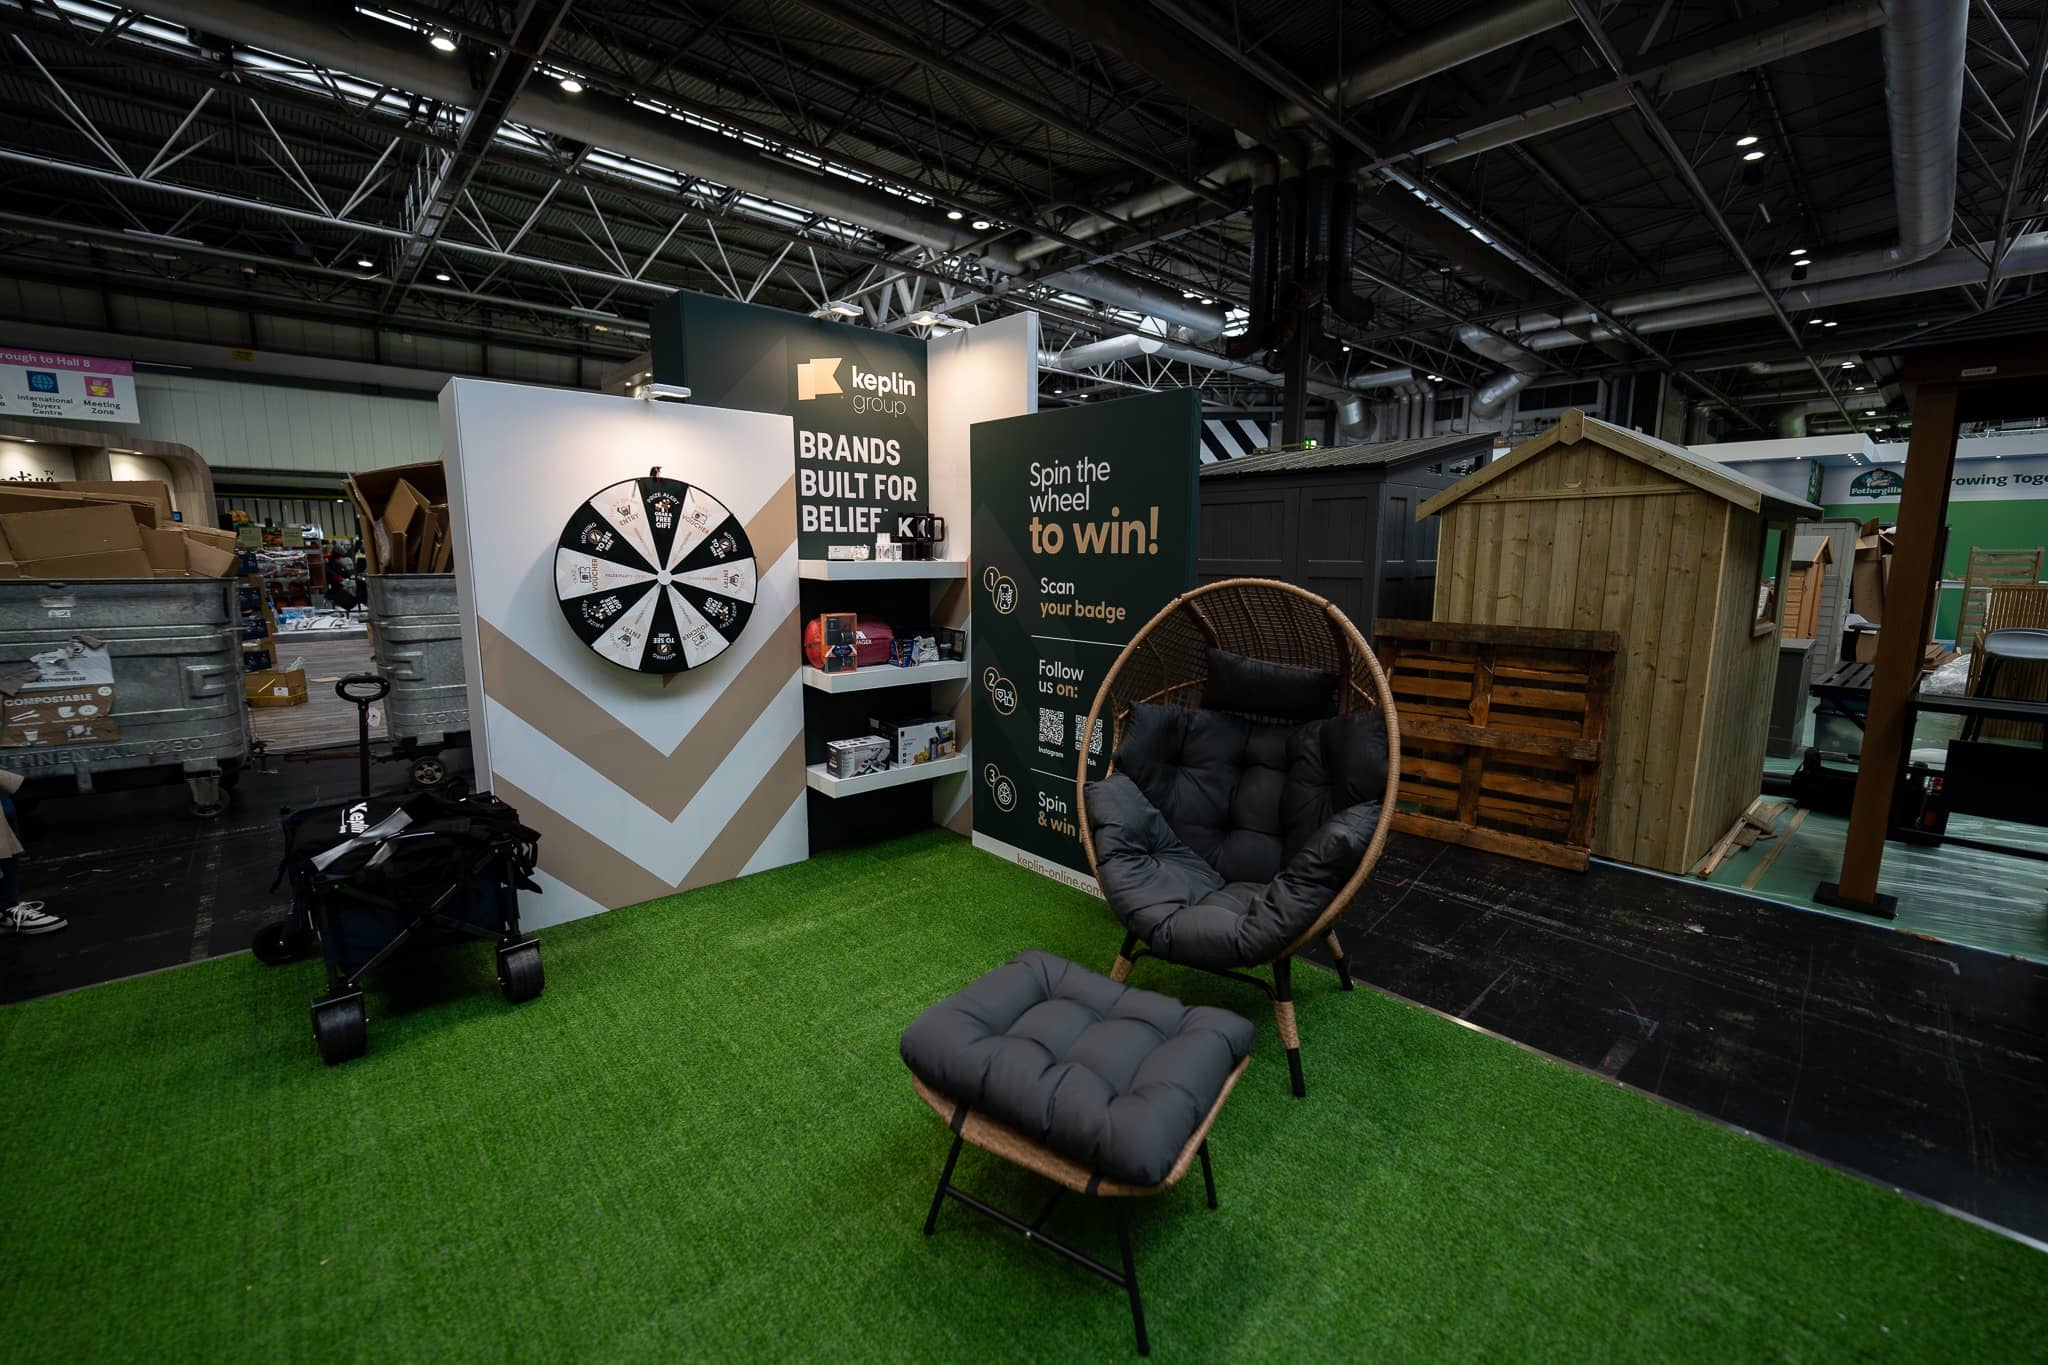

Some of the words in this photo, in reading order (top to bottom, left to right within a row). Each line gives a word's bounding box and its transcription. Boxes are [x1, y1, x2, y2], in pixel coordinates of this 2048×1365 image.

[0, 352, 37, 364] rough
[40, 355, 53, 364] to
[60, 358, 80, 367] Hall
[83, 360, 91, 368] 8
[852, 365, 915, 397] keplin
[84, 400, 121, 409] Meeting
[91, 408, 115, 416] Zone
[853, 394, 907, 418] group
[799, 430, 901, 466] BRANDS
[1030, 459, 1071, 492] Spin
[1076, 456, 1111, 483] the
[800, 468, 868, 499] BUILT
[874, 474, 918, 502] FOR
[662, 493, 680, 505] ALERT
[1030, 484, 1090, 513] wheel
[619, 513, 639, 526] ENTRY
[682, 513, 710, 534] VOUCHER
[898, 517, 914, 537] K
[1029, 516, 1064, 555] to
[1072, 506, 1159, 555] win!
[595, 542, 605, 551] TO
[989, 572, 995, 586] 1
[1040, 577, 1075, 595] Scan
[1040, 601, 1072, 618] your
[1075, 599, 1126, 624] badge
[682, 623, 710, 641] VOUCHER
[1039, 659, 1085, 681] Follow
[988, 673, 995, 687] 2
[1039, 680, 1054, 694] us
[1056, 683, 1079, 699] on:
[4, 693, 93, 707] COMPOSTABLE
[1038, 746, 1064, 758] Instagram
[989, 769, 995, 782] 3
[1038, 791, 1067, 814] Spin
[1037, 810, 1048, 828] &
[1050, 817, 1076, 837] win
